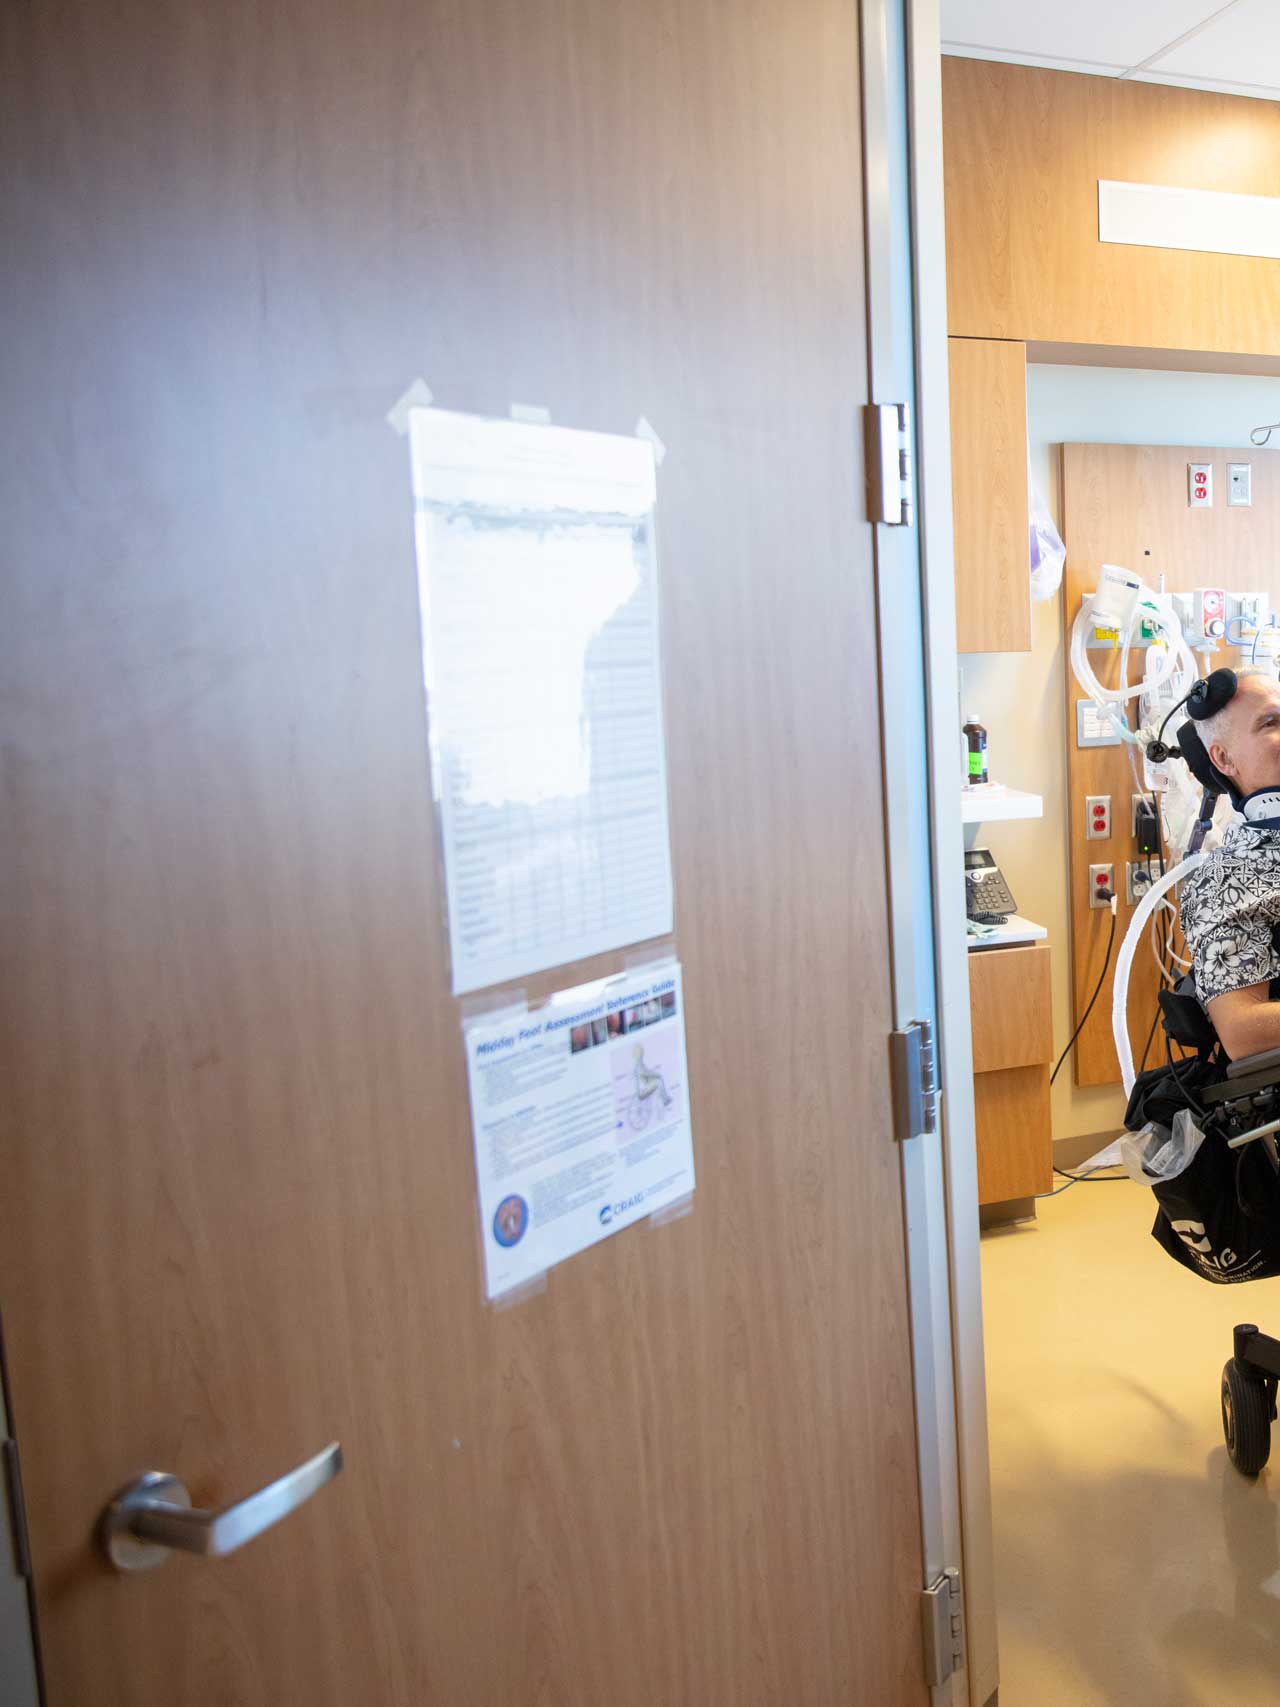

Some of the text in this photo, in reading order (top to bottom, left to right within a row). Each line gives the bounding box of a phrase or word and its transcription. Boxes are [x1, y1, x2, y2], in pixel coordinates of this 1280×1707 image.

[476, 979, 675, 1056] Midday Foot Assessment Reference Guide
[613, 1191, 645, 1214] CRAIG
